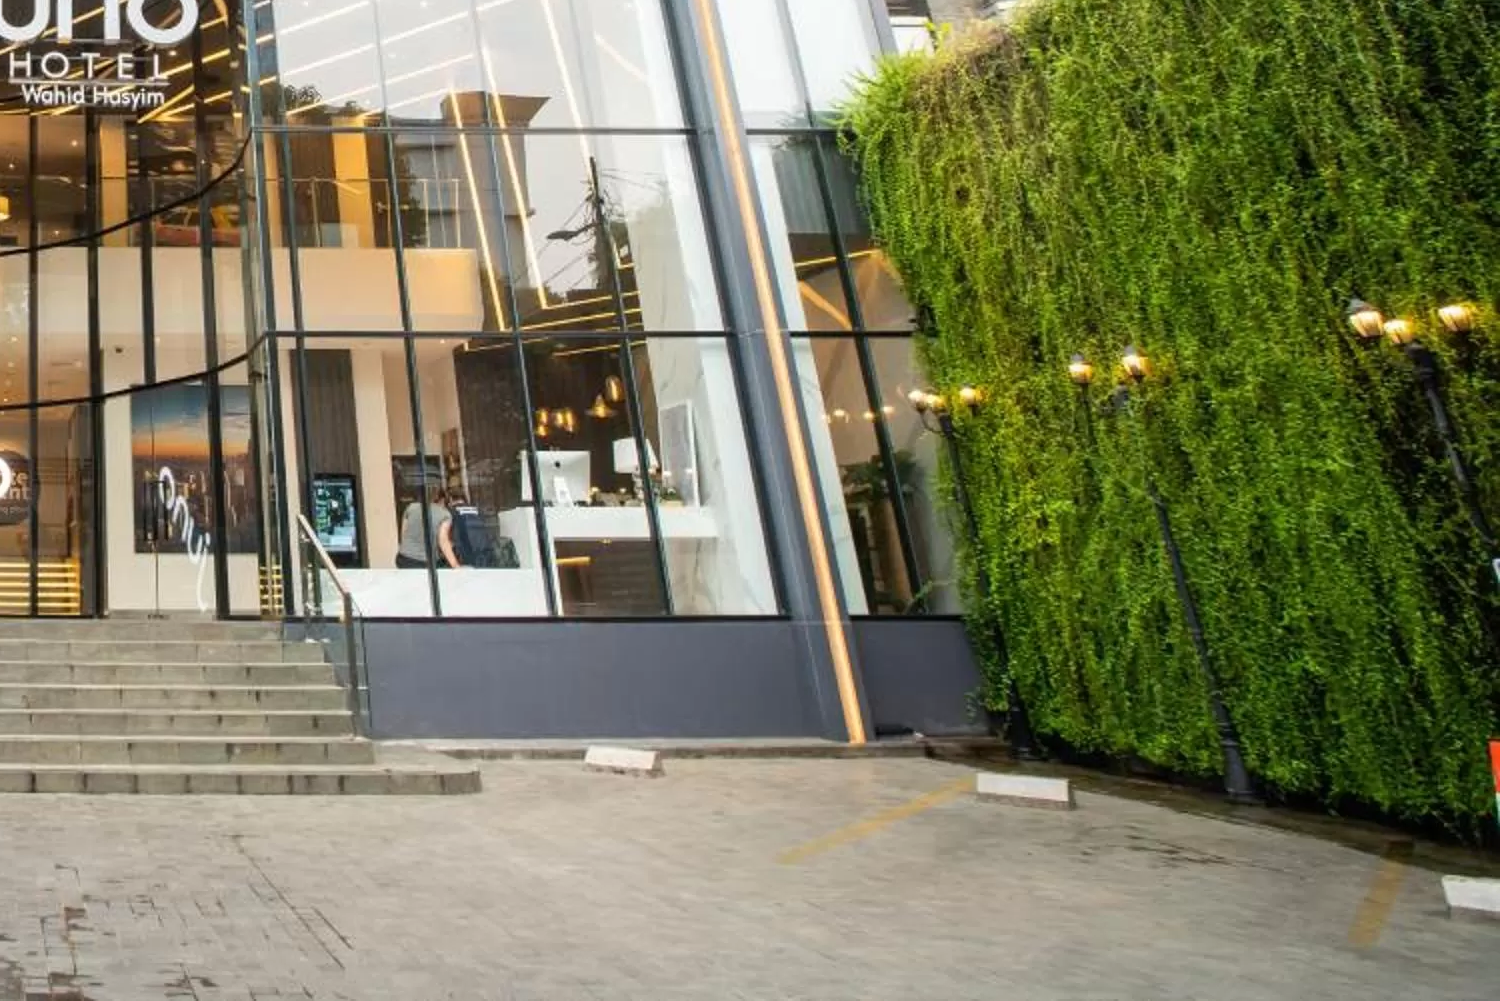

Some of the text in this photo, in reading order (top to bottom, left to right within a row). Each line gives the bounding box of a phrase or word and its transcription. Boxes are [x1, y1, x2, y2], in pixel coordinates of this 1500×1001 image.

[8, 51, 169, 82] HOTEL
[21, 83, 165, 111] Wahid Hasyim
